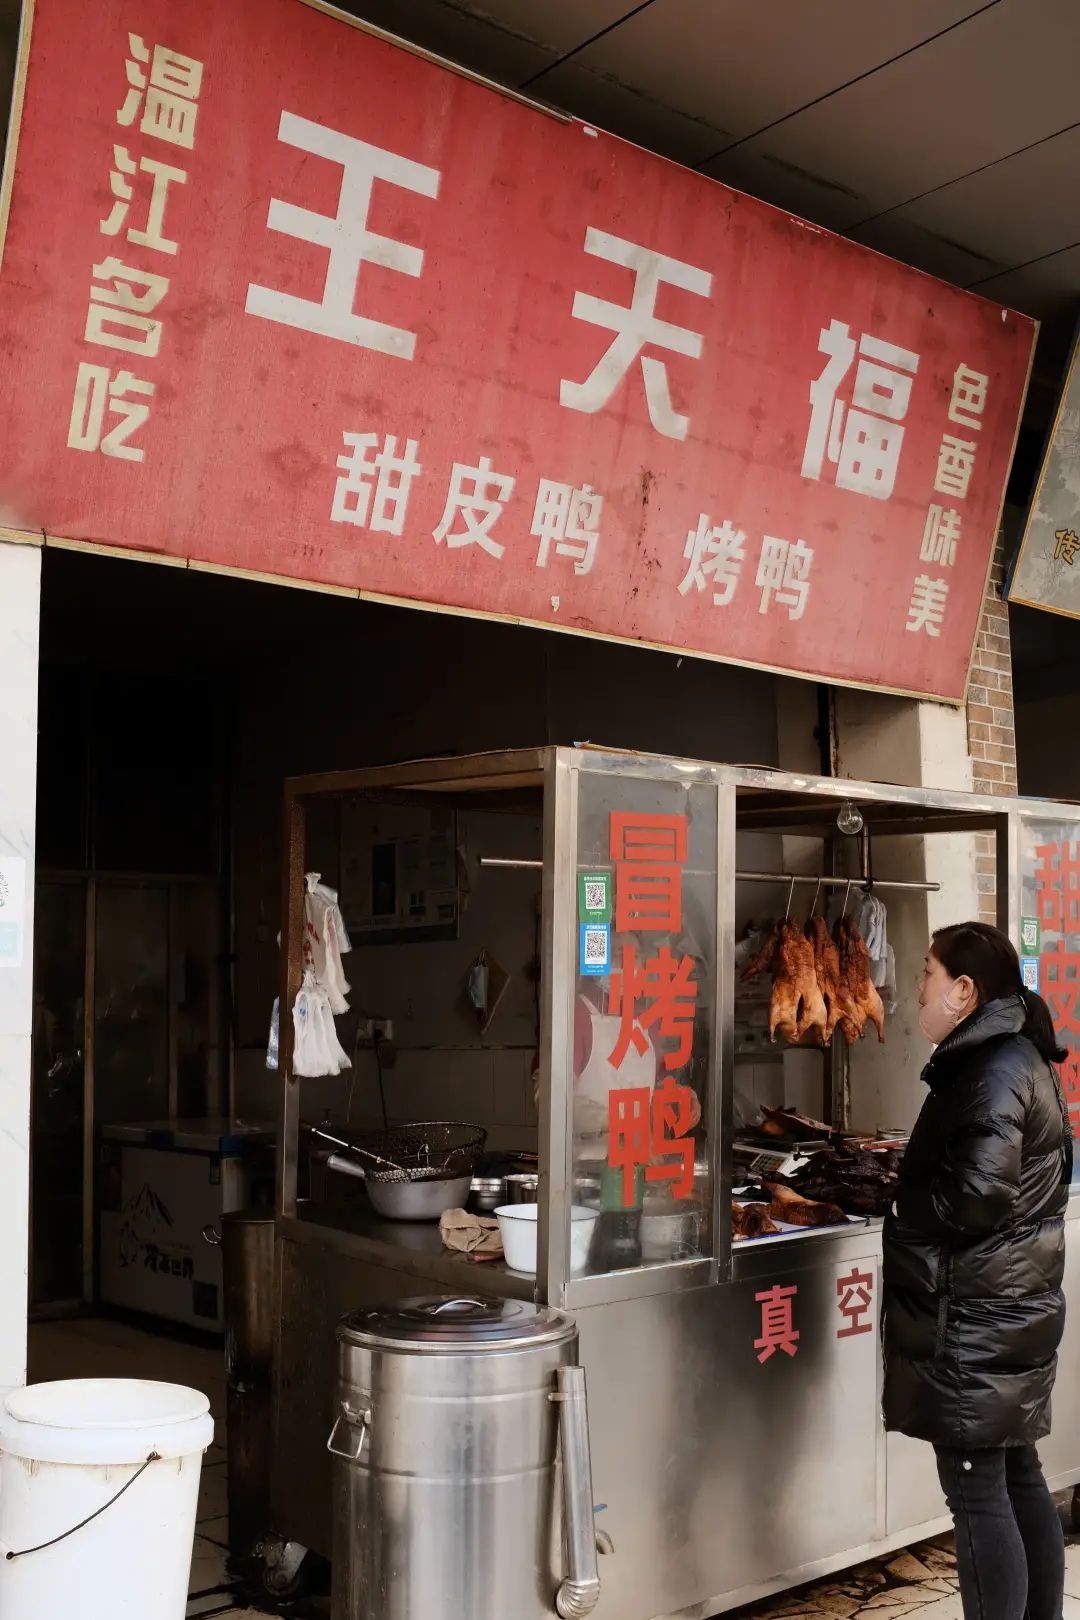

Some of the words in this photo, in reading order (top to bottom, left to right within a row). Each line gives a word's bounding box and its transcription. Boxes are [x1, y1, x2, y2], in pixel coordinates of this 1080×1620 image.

[67, 32, 204, 463] 温江名吃
[244, 110, 920, 500] 王天福
[330, 431, 604, 577] 甜皮鸭
[677, 513, 815, 621] 烤鸭
[905, 363, 990, 638] 色香味美
[607, 811, 698, 1208] 冒烤鸭
[754, 1267, 873, 1364] 真空
